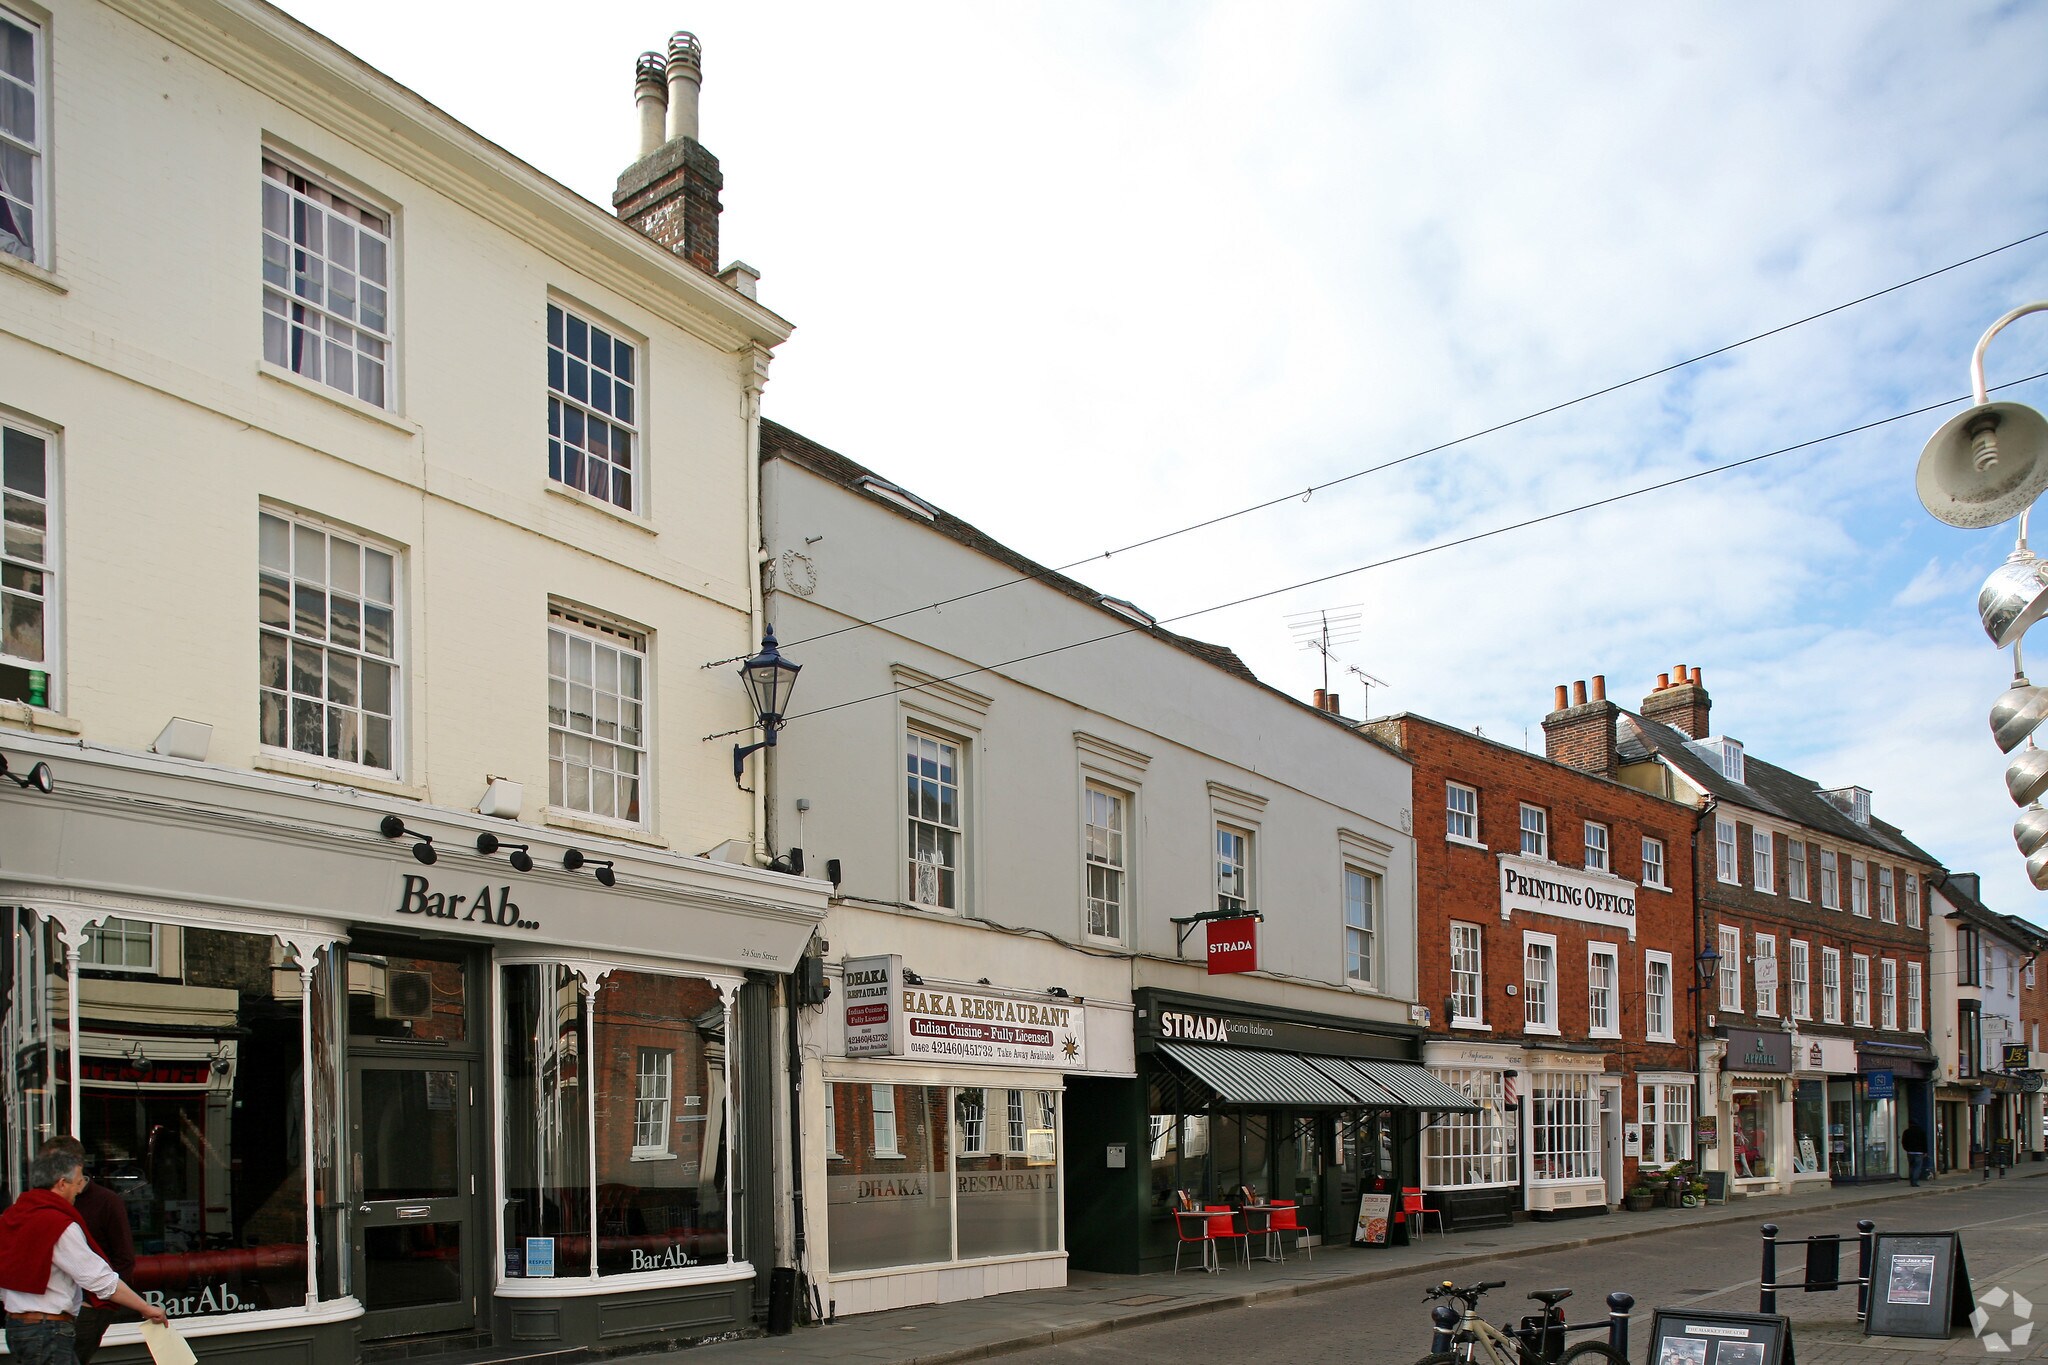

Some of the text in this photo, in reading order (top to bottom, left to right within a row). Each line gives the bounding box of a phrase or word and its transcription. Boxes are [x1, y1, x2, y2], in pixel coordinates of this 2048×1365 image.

[396, 874, 540, 930] Bar Ab...
[1505, 868, 1635, 916] PRINTING OFFICE
[750, 950, 761, 958] Sun
[762, 951, 778, 961] Street
[1210, 940, 1252, 953] STRADA
[846, 969, 888, 986] DHAKA
[847, 987, 888, 999] RESTAURANT
[848, 1007, 864, 1015] Indian
[851, 1016, 864, 1024] Fully
[903, 991, 1069, 1028] HAKA RESTAURANT
[915, 1020, 947, 1035] Indian
[949, 1023, 982, 1038] Cuisine
[991, 1027, 1014, 1042] Fully
[1015, 1029, 1050, 1044] Licensed
[1162, 1011, 1273, 1042] STRADA Cucina Italiana
[911, 1041, 1054, 1061] 01462 421460/451732 Take Away Available
[1745, 1053, 1777, 1065] APPAREL
[858, 1173, 1055, 1198] DHAKA RESTAURANT
[630, 1244, 698, 1271] Bar Ab...
[143, 1282, 256, 1316] Bar Ab...
